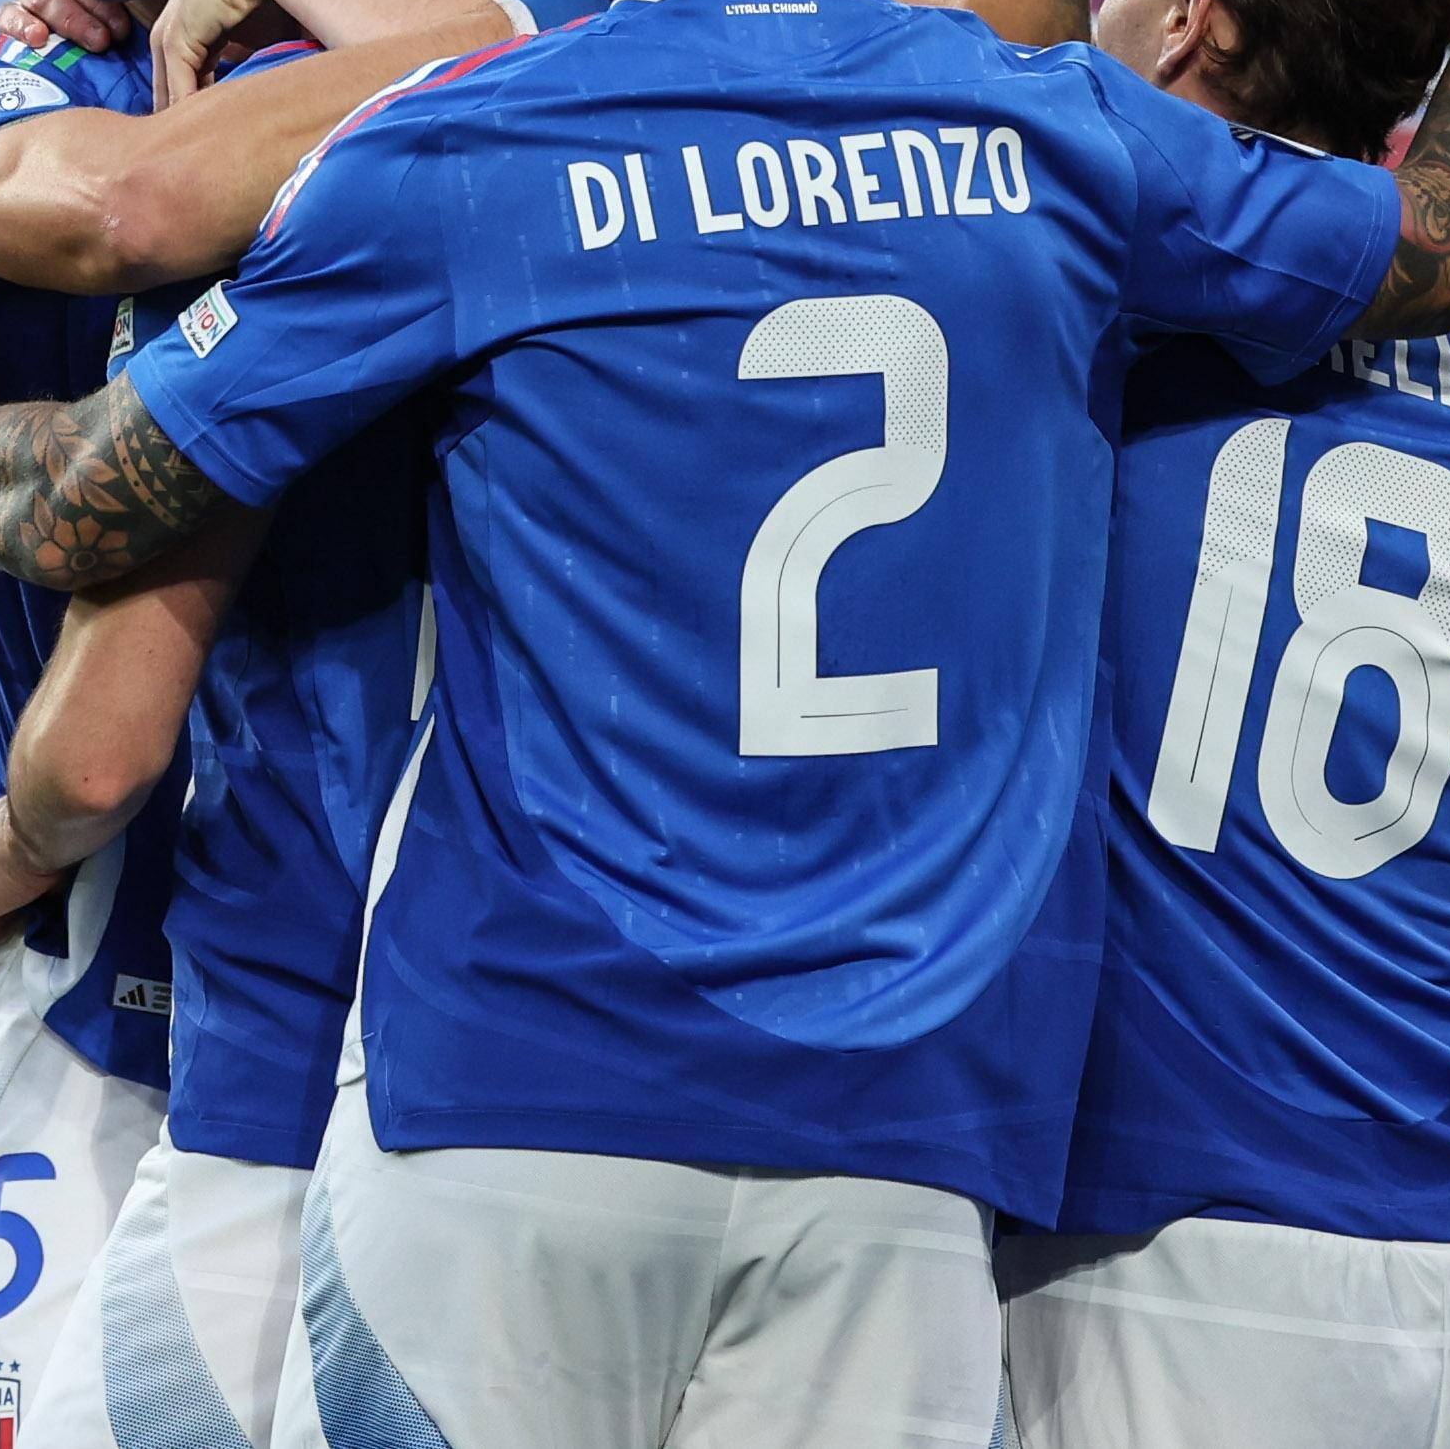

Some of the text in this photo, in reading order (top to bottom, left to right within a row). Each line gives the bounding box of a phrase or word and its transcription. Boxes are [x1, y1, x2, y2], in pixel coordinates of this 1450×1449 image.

[725, 1, 818, 15] L'ITALIA CHIAMÒ
[567, 126, 1032, 251] DI LORENZO
[738, 294, 949, 756] 2
